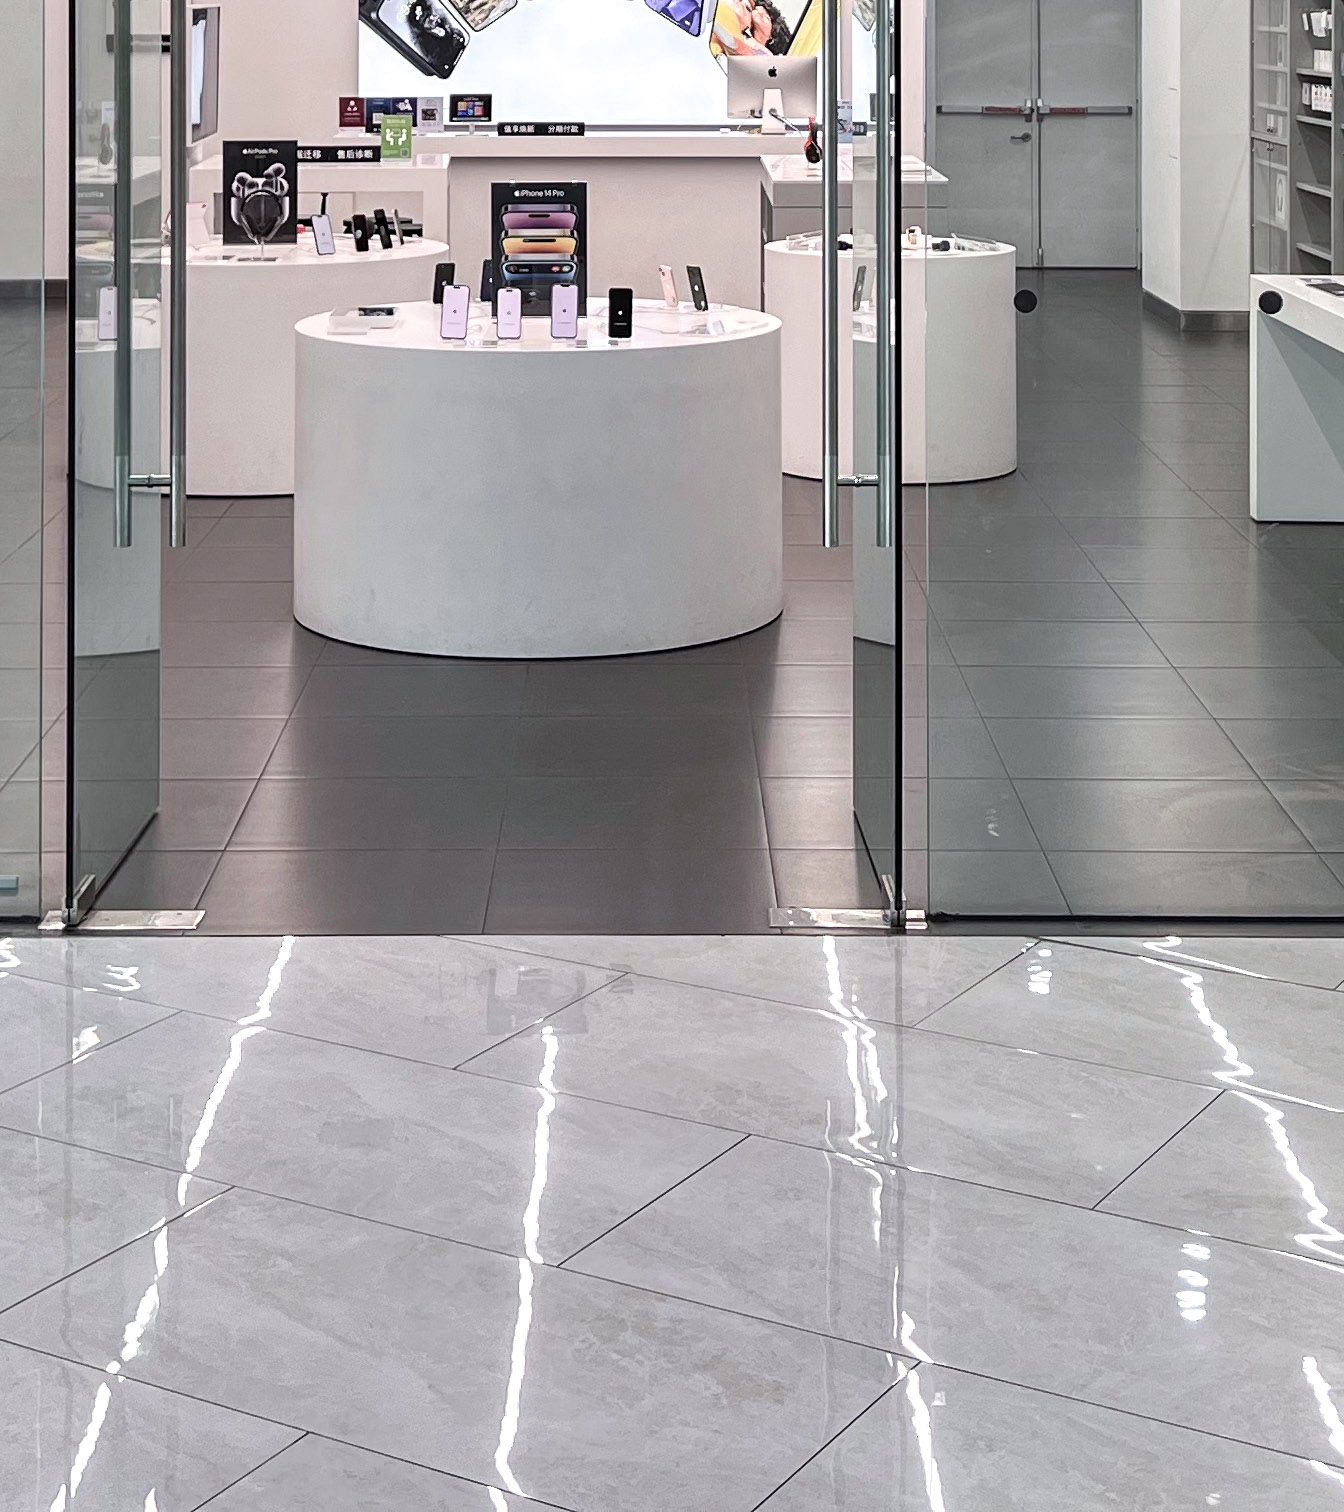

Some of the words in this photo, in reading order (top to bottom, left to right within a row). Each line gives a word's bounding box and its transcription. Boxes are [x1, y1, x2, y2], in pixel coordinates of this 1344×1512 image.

[336, 149, 374, 160] 售后诊断
[520, 189, 544, 198] iPhone
[544, 189, 552, 198] 14
[552, 189, 565, 198] Pro
